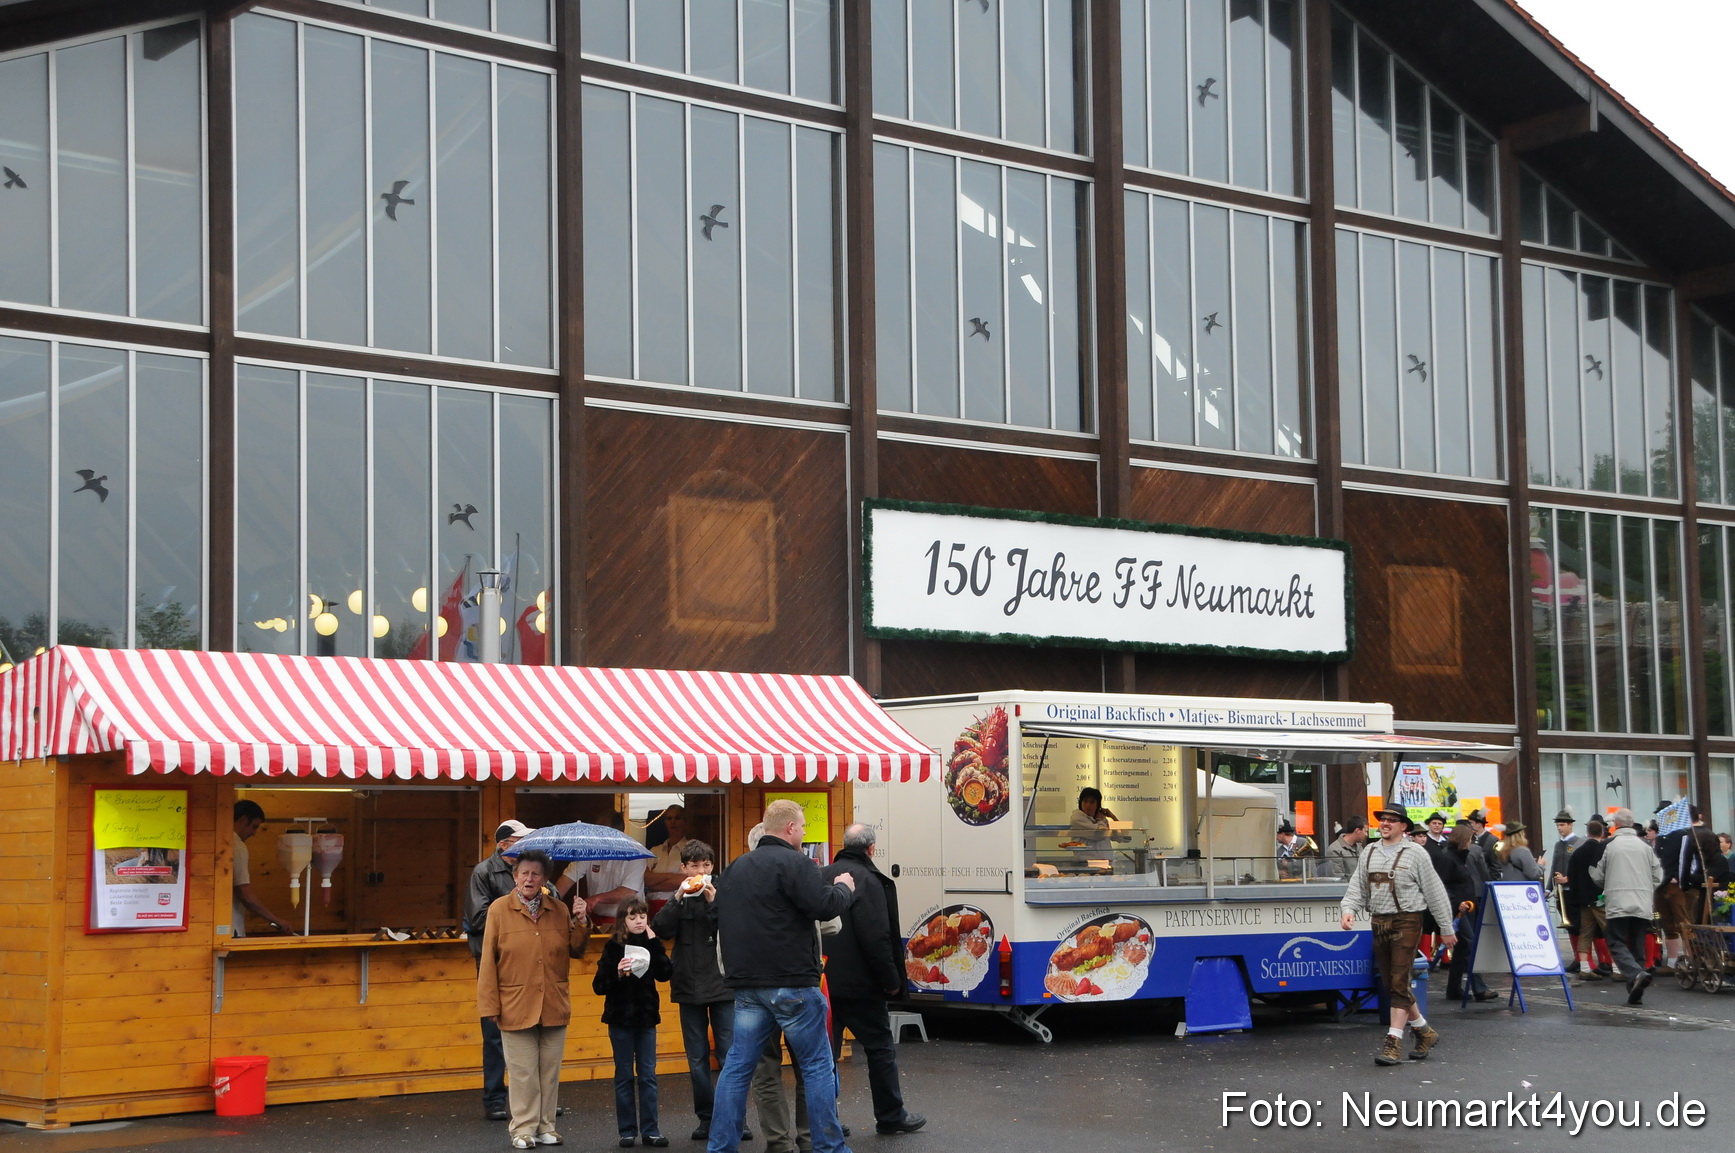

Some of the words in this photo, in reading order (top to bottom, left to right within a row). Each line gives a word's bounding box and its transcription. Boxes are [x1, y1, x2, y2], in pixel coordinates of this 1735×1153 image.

[924, 540, 996, 597] 150
[1003, 548, 1102, 617] Jahre
[1112, 556, 1164, 610] FF
[1166, 564, 1316, 619] Neumarkt
[1046, 704, 1101, 722] Original
[1105, 706, 1166, 722] Backfisch
[1178, 708, 1224, 726] Matjes-
[1228, 710, 1288, 725] Bismarck-
[1291, 712, 1366, 728] Lachssemmel
[902, 866, 946, 877] PARTYSERVICE
[952, 867, 970, 877] FISCH
[976, 867, 1009, 877] FEINKOST
[1164, 908, 1262, 928] PARTYSERVICE
[1273, 906, 1312, 924] FISCH
[1500, 903, 1533, 911] Backfisch
[1056, 917, 1080, 940] Original
[1080, 906, 1111, 922] Backfisch
[1511, 942, 1544, 950] Backfisch
